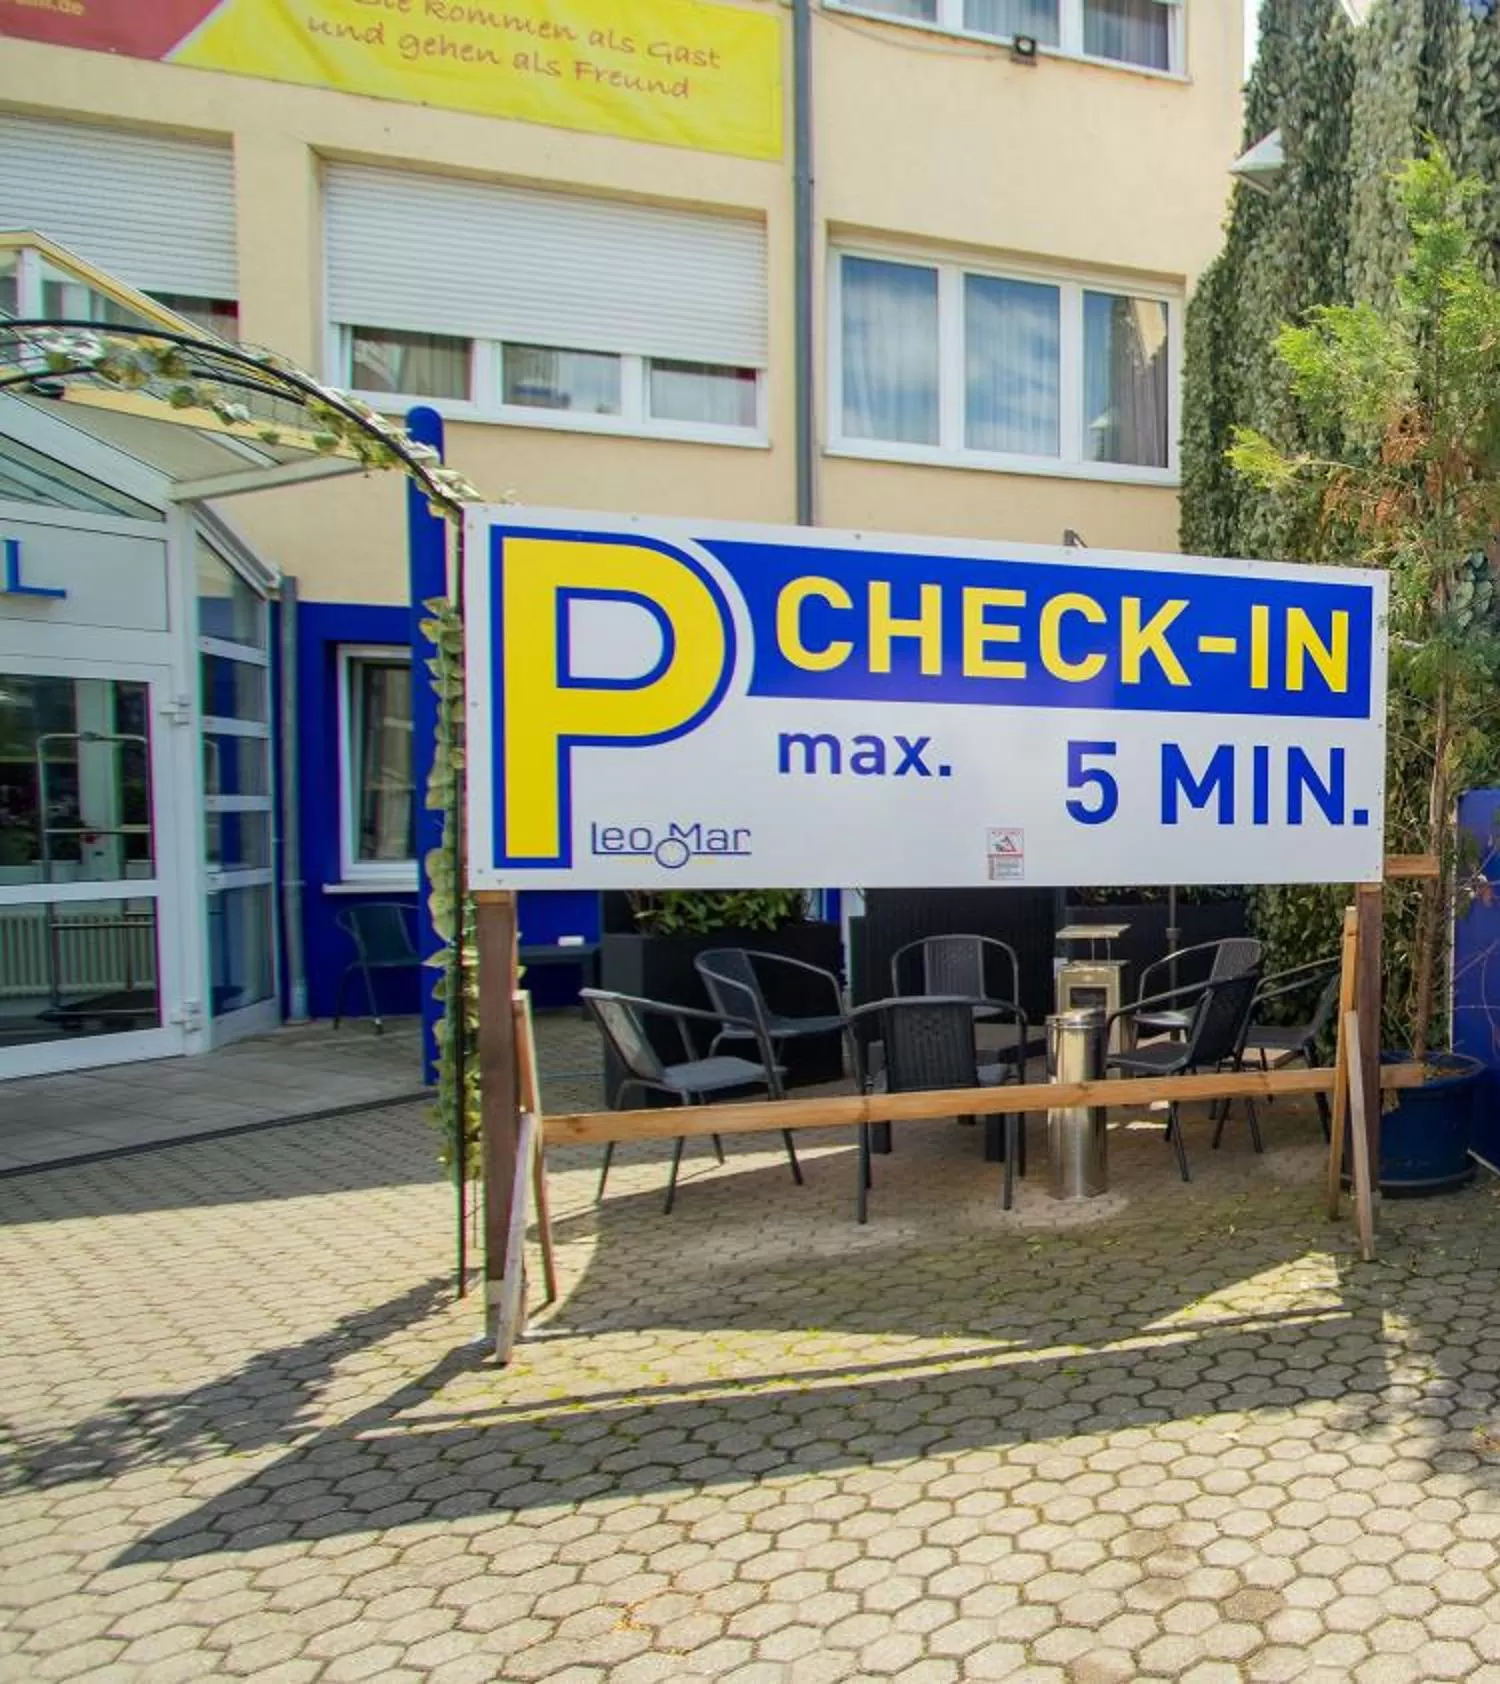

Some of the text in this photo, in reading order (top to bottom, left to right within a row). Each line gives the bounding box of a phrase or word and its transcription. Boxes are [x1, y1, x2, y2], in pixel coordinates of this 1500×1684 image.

[307, 15, 690, 100] und gehen als Freund
[354, 0, 721, 69] ie kommen als Gast
[776, 576, 1350, 693] CHECK-IN
[492, 527, 736, 867] P
[777, 731, 1371, 827] max. 5 MIN.
